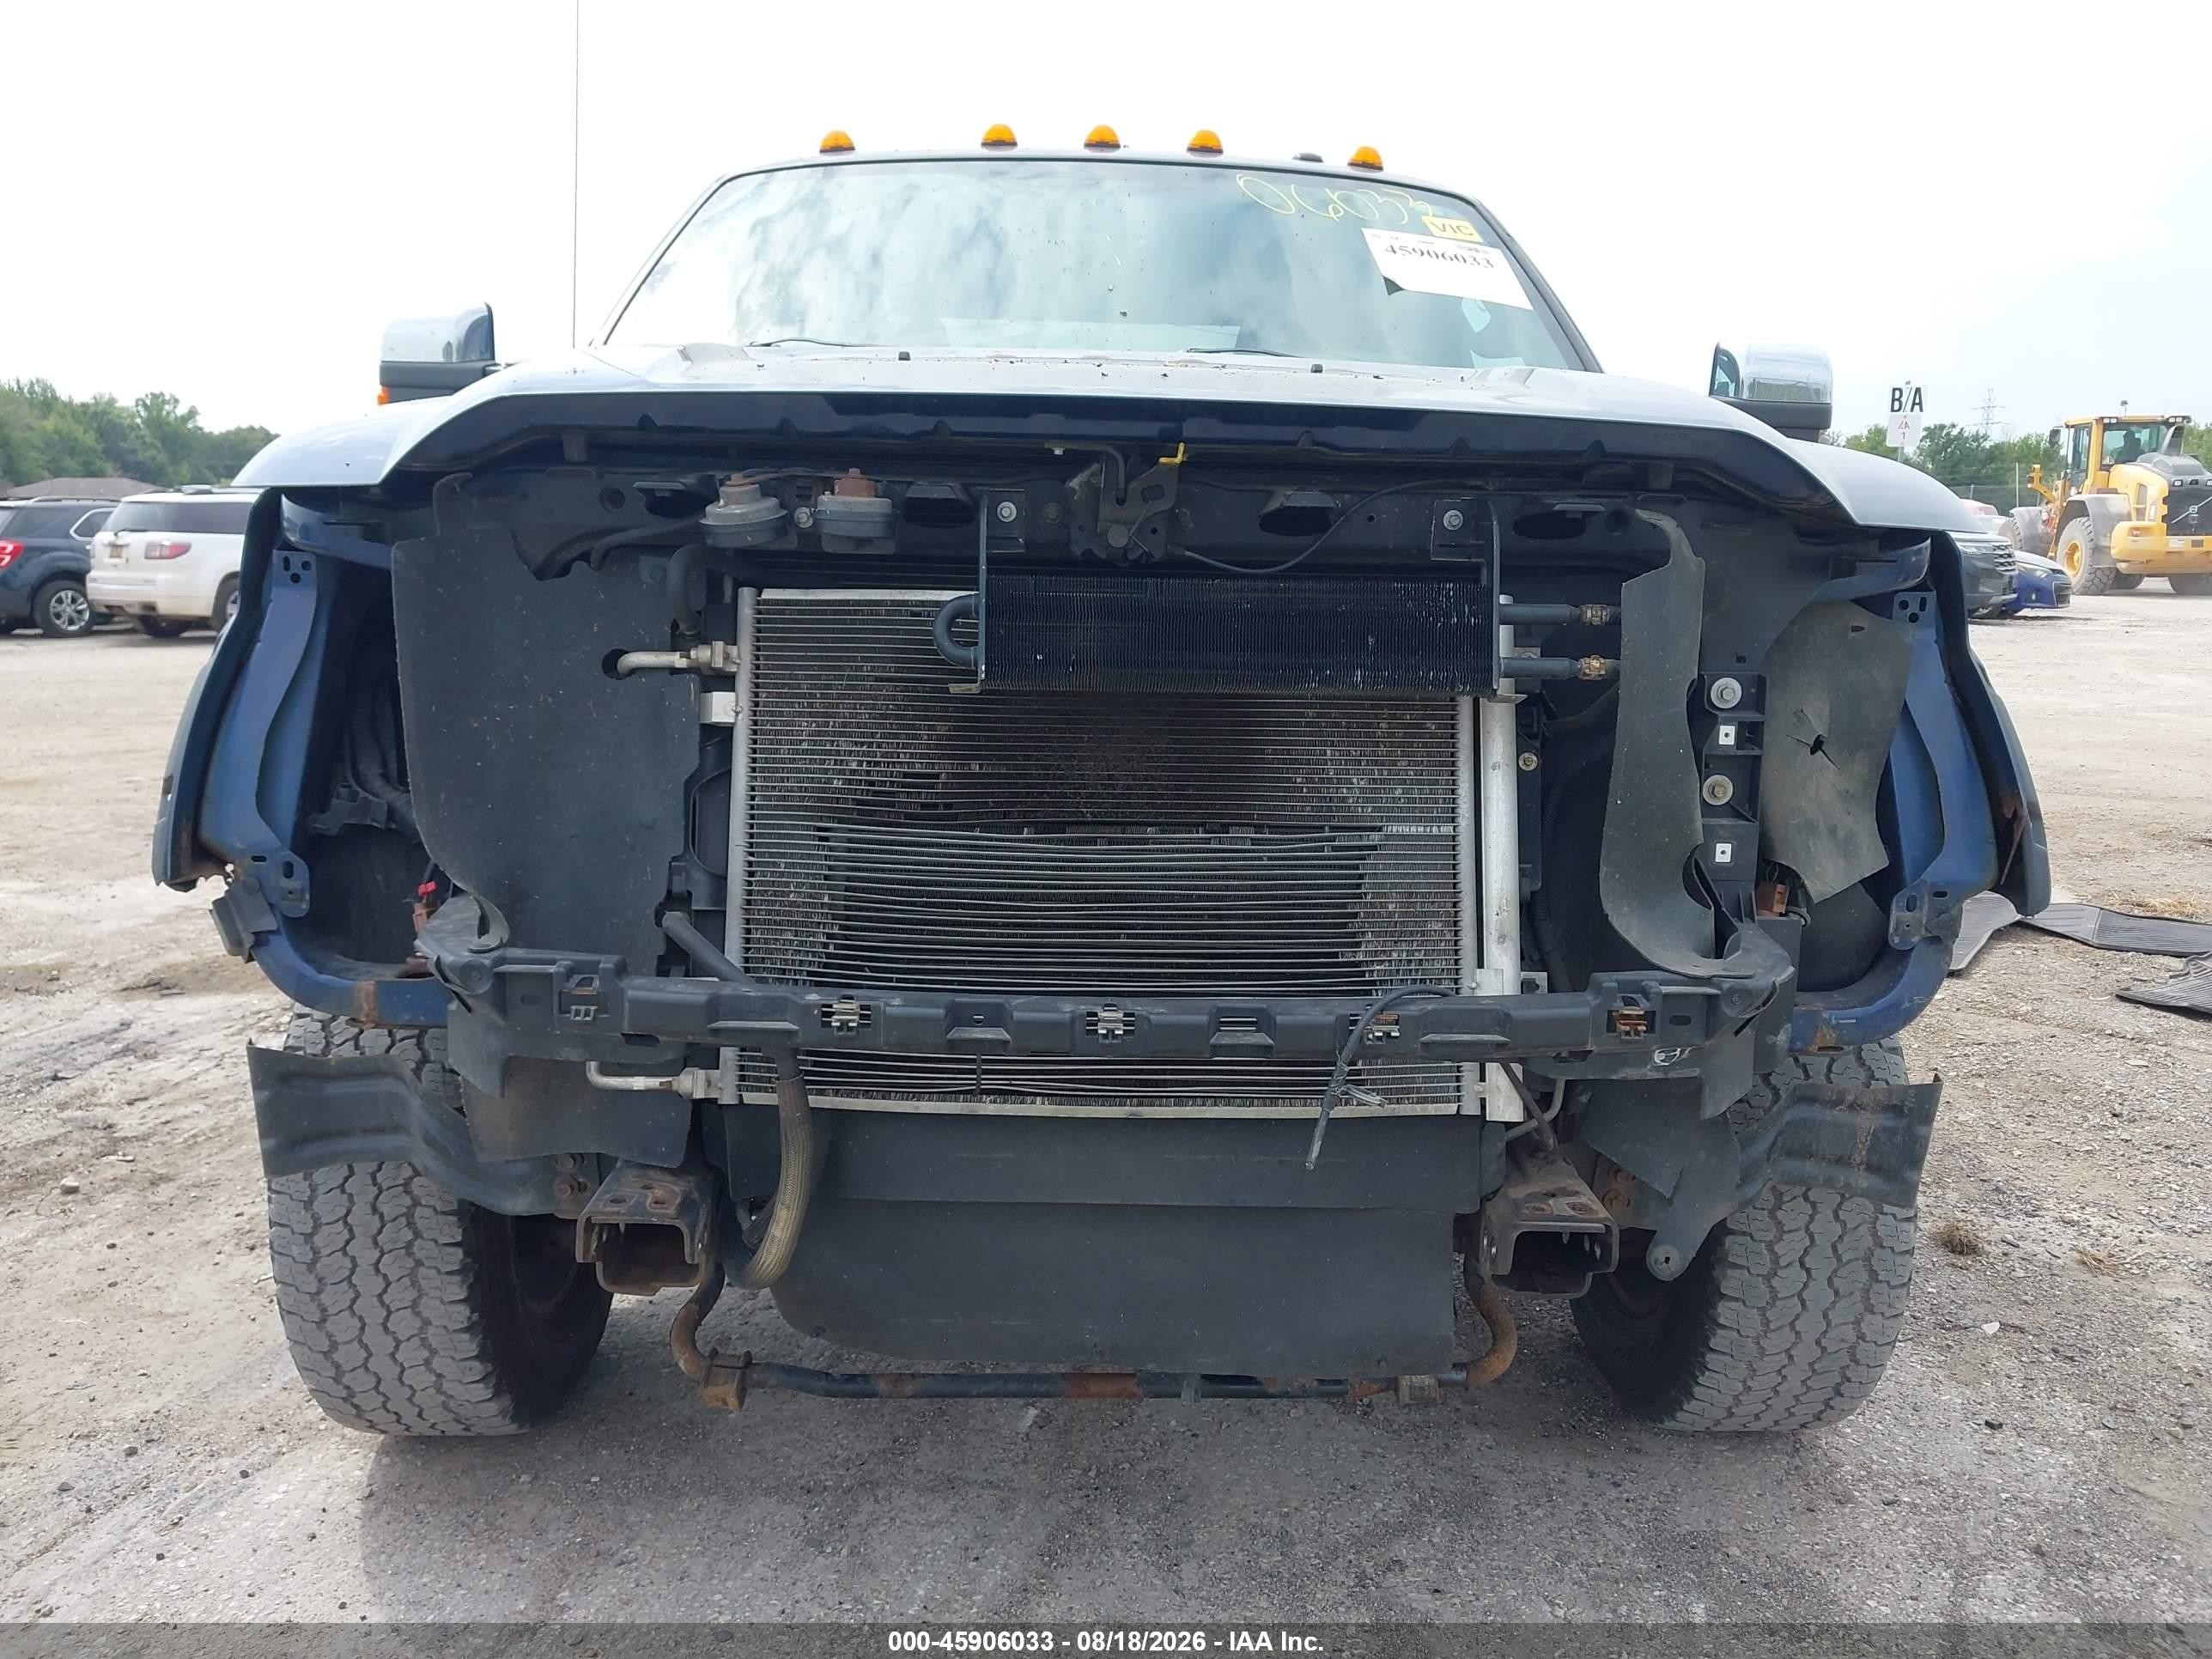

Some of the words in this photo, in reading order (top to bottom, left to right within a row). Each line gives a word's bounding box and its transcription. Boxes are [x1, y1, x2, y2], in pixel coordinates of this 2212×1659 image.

[1430, 221, 1474, 236] VIC
[1384, 244, 1495, 269] 45906033
[1890, 386, 1924, 413] B/A
